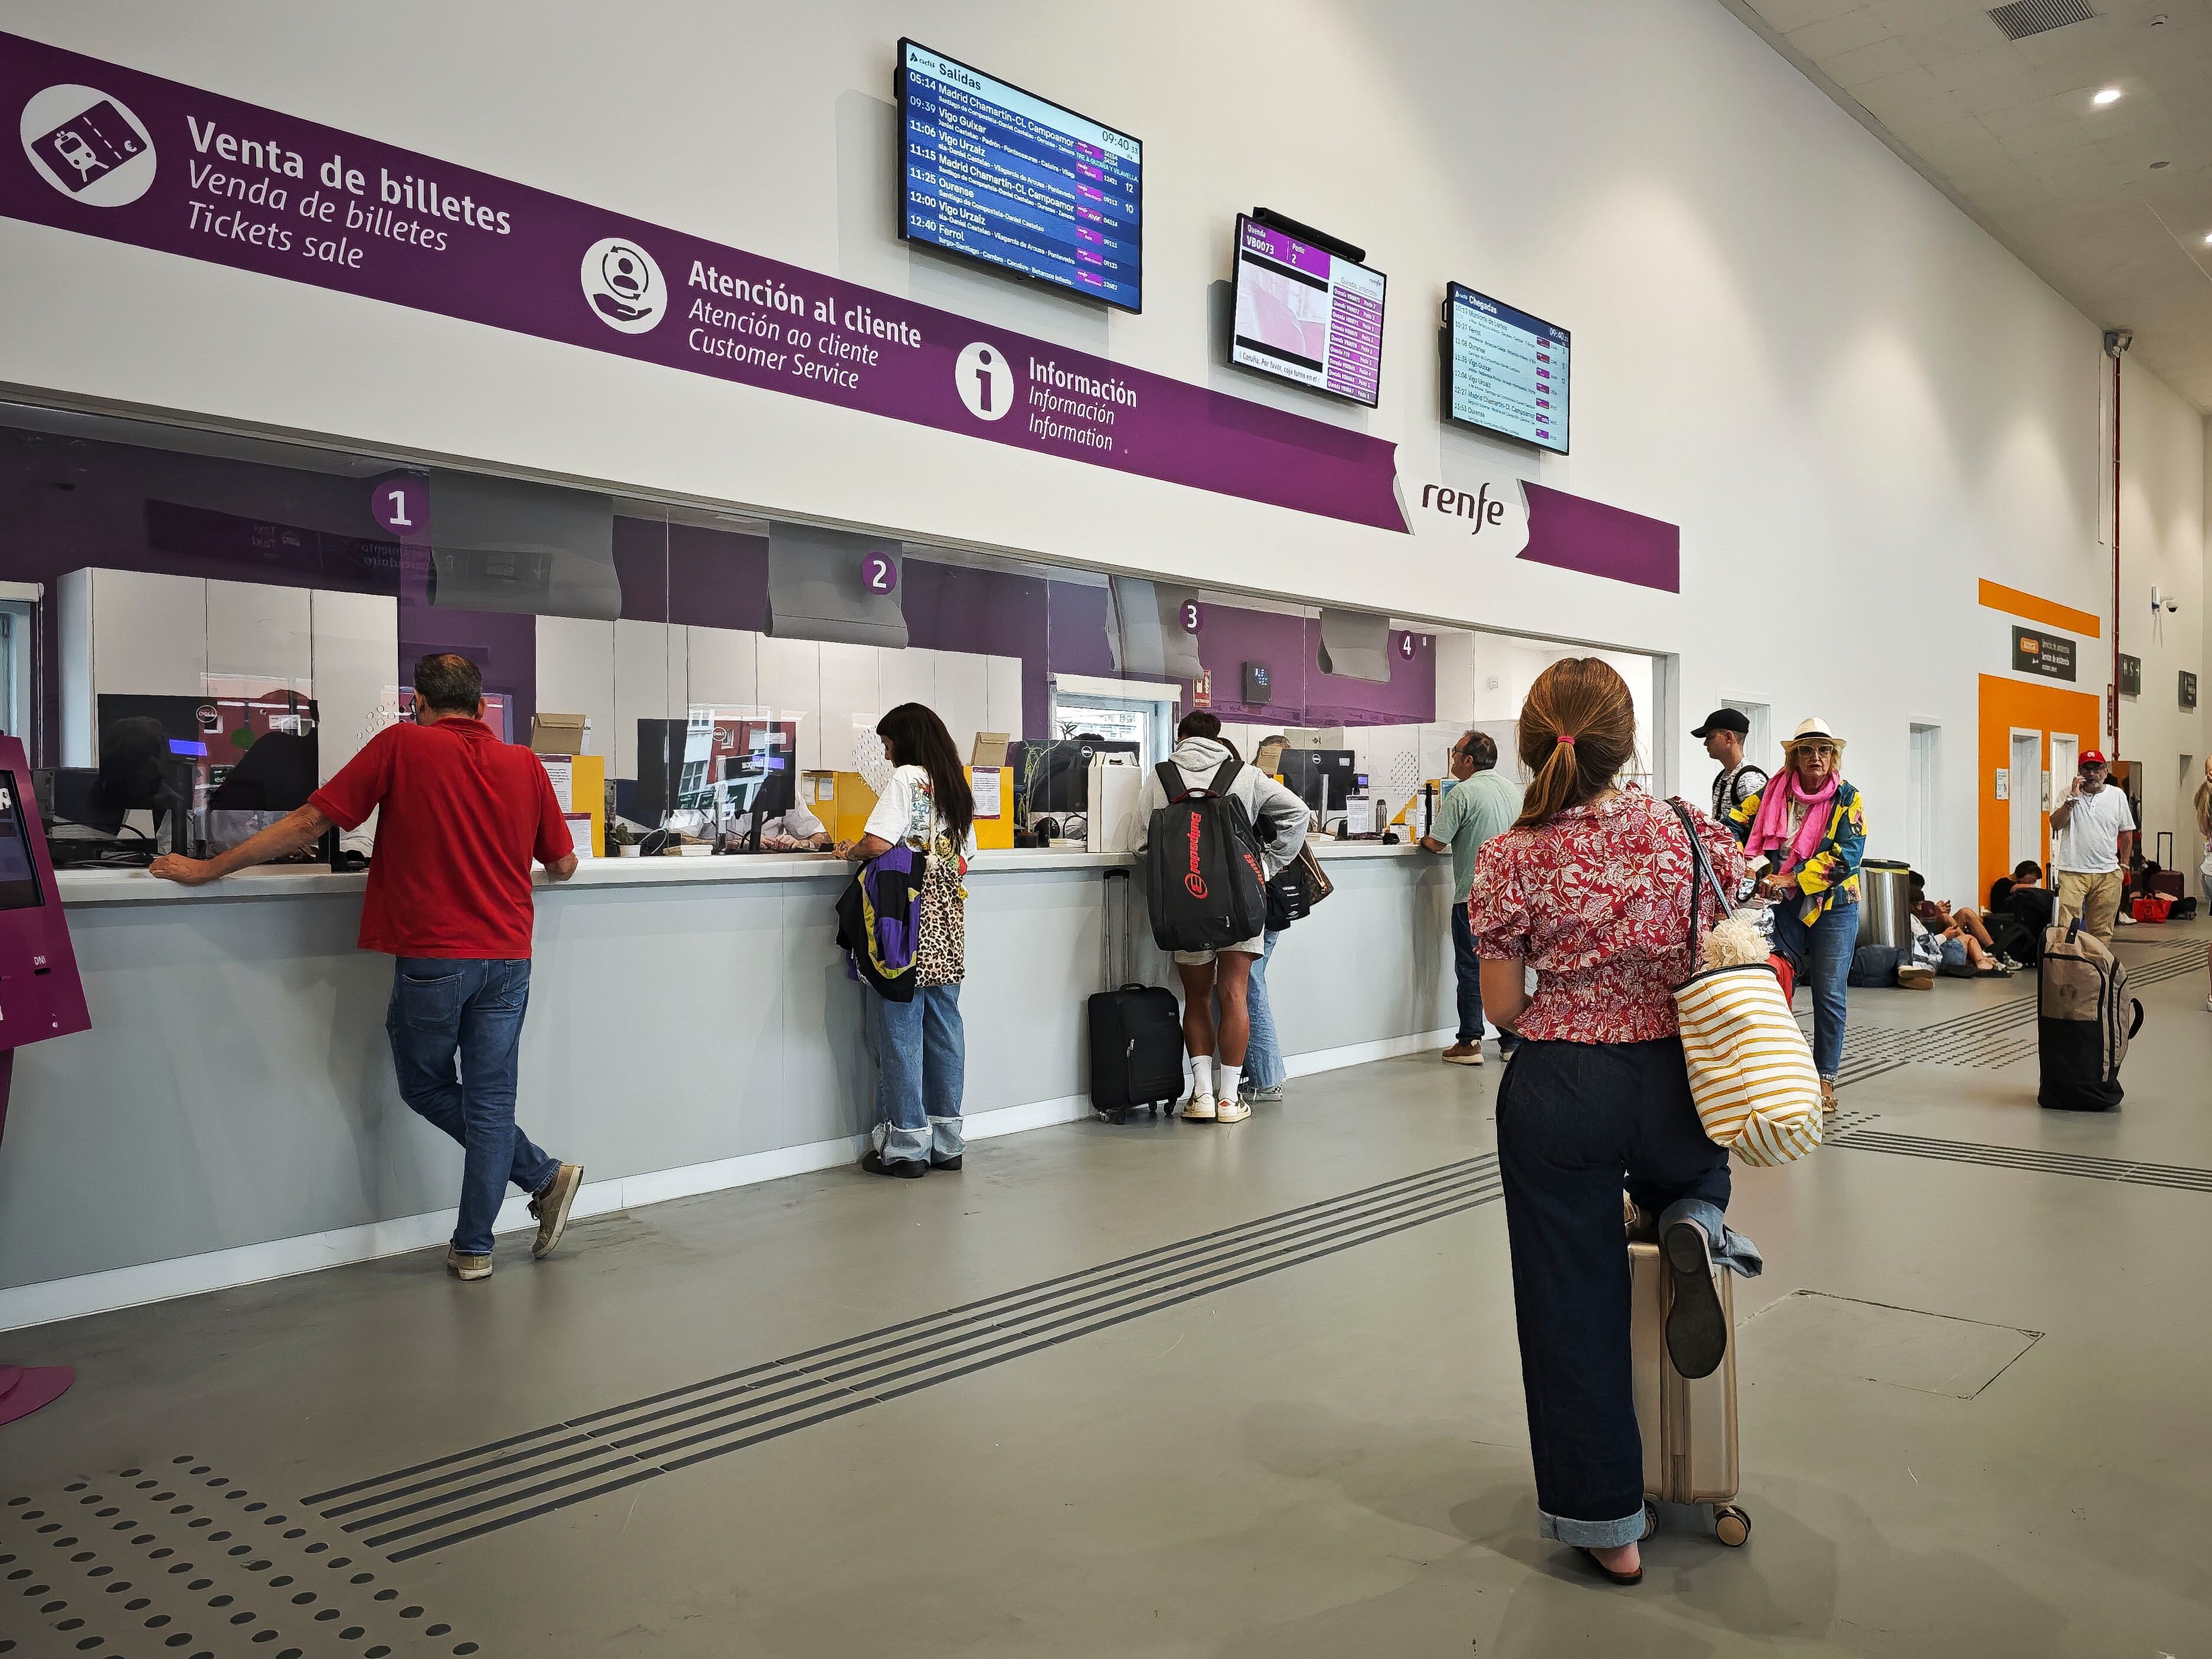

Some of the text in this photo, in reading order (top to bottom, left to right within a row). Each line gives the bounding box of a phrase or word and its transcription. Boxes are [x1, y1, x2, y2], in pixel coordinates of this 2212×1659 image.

[939, 63, 981, 90] Salidas
[910, 71, 936, 90] 05:14
[938, 83, 968, 104] Madrid
[1028, 120, 1074, 148] Campoamor
[910, 95, 936, 114] 09:39
[938, 107, 958, 125] Vigo
[910, 119, 986, 157] 11:06 Vigo Urzaiz
[1102, 130, 1138, 155] 09:40 33
[187, 116, 511, 234] Venta de billetes
[910, 143, 936, 161] 11:15
[939, 154, 968, 173] Madrid
[1028, 187, 1074, 213] Campoamor
[910, 167, 973, 198] 11:25 Ourense
[1125, 182, 1133, 194] 12
[190, 160, 448, 251] Venda de billetes
[910, 191, 986, 226] 12:00 Vigo Urzaiz
[939, 190, 962, 204] Santiago
[1125, 203, 1133, 214] 10
[189, 201, 364, 268] Tickets sale
[910, 214, 964, 241] 12:40 Ferrol
[1247, 224, 1266, 239] Quenda
[1246, 235, 1274, 255] VB0073
[1292, 243, 1305, 254] Posto
[1291, 254, 1296, 264] 2
[1369, 276, 1381, 288] renfe
[689, 261, 922, 348] Atención al cliente
[1469, 295, 1497, 316] Chegadas
[689, 299, 878, 367] Atención ao cliente
[1455, 320, 1481, 336] 10:27 Ferrol
[1549, 327, 1564, 341] 09:40
[689, 329, 858, 390] Customer Service
[1242, 352, 1260, 365] Coruña.
[1269, 362, 1283, 373] favor,
[1283, 366, 1293, 377] coja
[1293, 370, 1305, 379] turno
[1468, 358, 1477, 368] Vigo
[1030, 357, 1137, 407] Información
[1455, 369, 1466, 379] 12:04
[1468, 374, 1477, 384] Vigo
[1029, 387, 1115, 426] Información
[1454, 386, 1466, 396] 12:27
[1468, 390, 1482, 401] Madrid
[1454, 402, 1466, 412] 13:53
[1468, 406, 1485, 418] Ourense
[1029, 414, 1113, 451] Information
[387, 491, 411, 526] 1
[1422, 482, 1504, 535] renfe
[872, 560, 887, 589] 2
[1187, 605, 1197, 629] 3
[1403, 636, 1411, 654] 4
[34, 955, 45, 965] DNI
